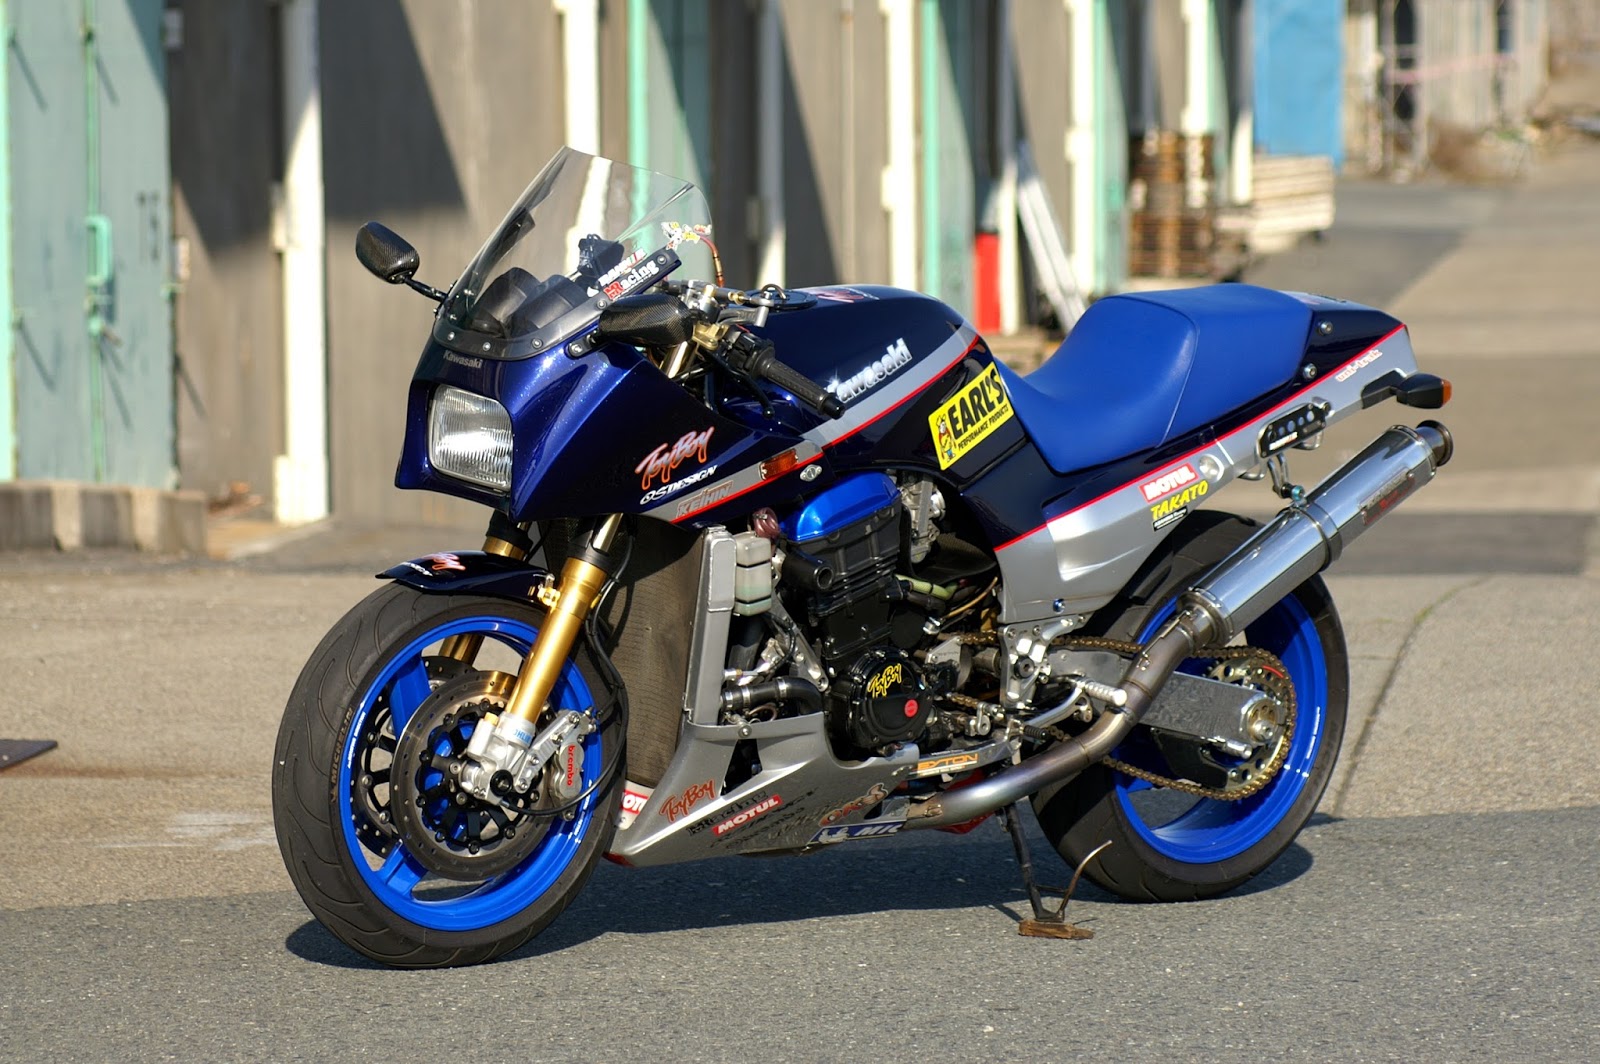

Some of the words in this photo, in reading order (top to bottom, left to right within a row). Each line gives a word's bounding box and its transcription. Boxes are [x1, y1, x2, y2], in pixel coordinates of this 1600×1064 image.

[443, 349, 484, 369] Kawasaki
[948, 368, 1005, 440] EARL'S
[957, 422, 989, 451] PERFORMANCE
[988, 403, 1009, 427] PRODUCTS
[1143, 465, 1196, 501] MOTUL
[1150, 480, 1209, 520] TAKATO
[566, 743, 576, 787] brembo
[717, 797, 779, 834] MOTUL
